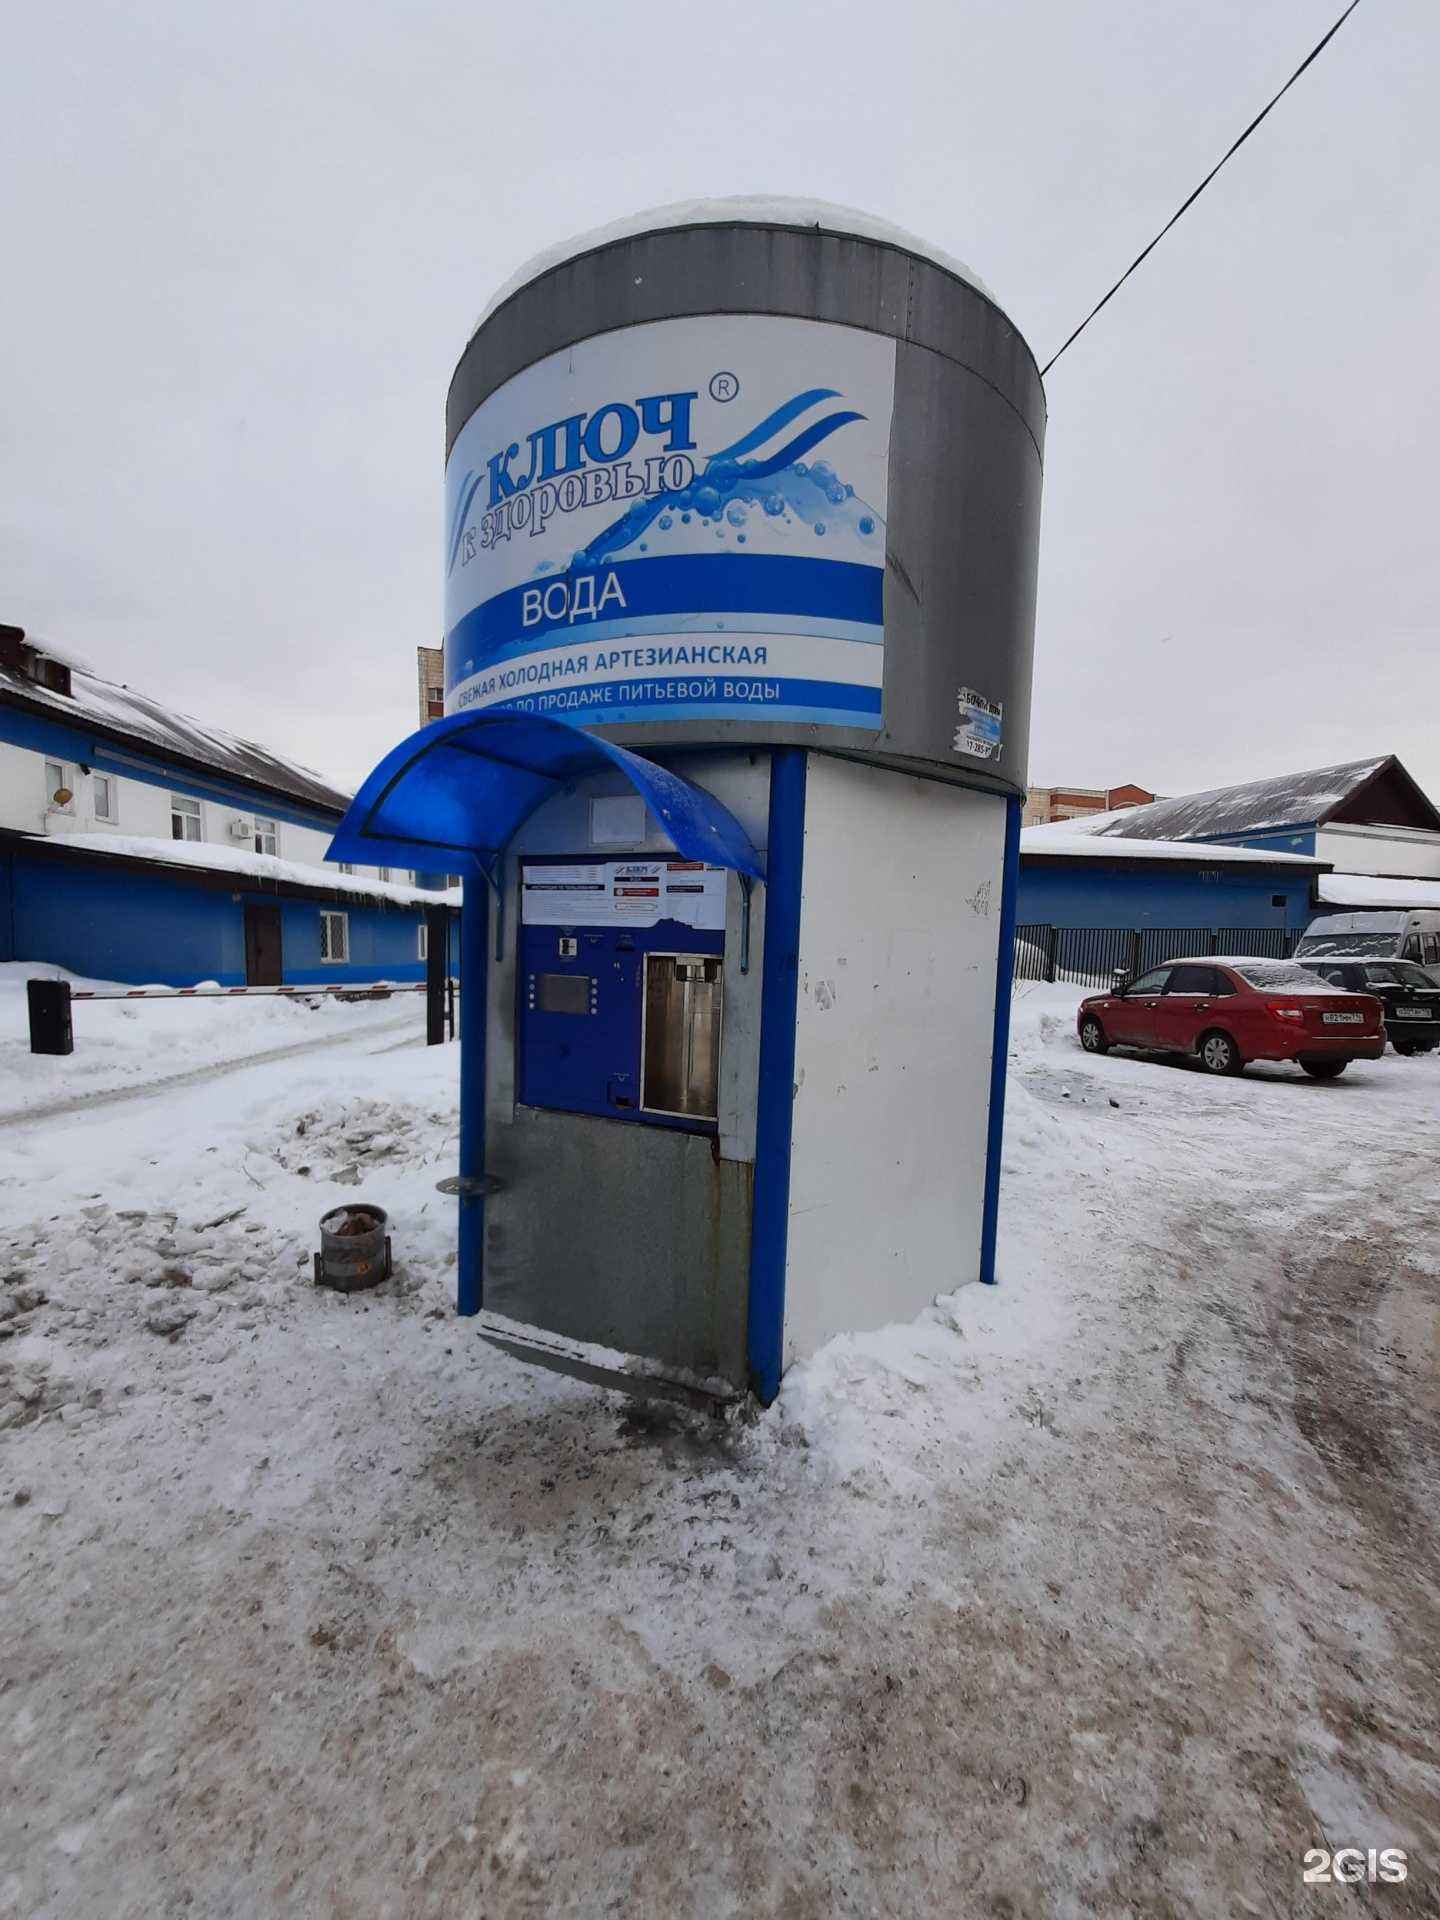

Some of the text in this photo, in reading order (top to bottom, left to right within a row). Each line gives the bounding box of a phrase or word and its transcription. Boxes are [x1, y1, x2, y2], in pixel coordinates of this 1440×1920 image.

[487, 392, 698, 510] КЛЮЧ
[522, 572, 627, 627] ВОДА
[458, 646, 767, 708] СВЕЖАЯ ХОЛОДНАЯ АРТЕЗИАНСКАЯ
[516, 678, 780, 712] ПО ПРОДАЖЕ ПИТЬЕВОЙ ВОДЫ
